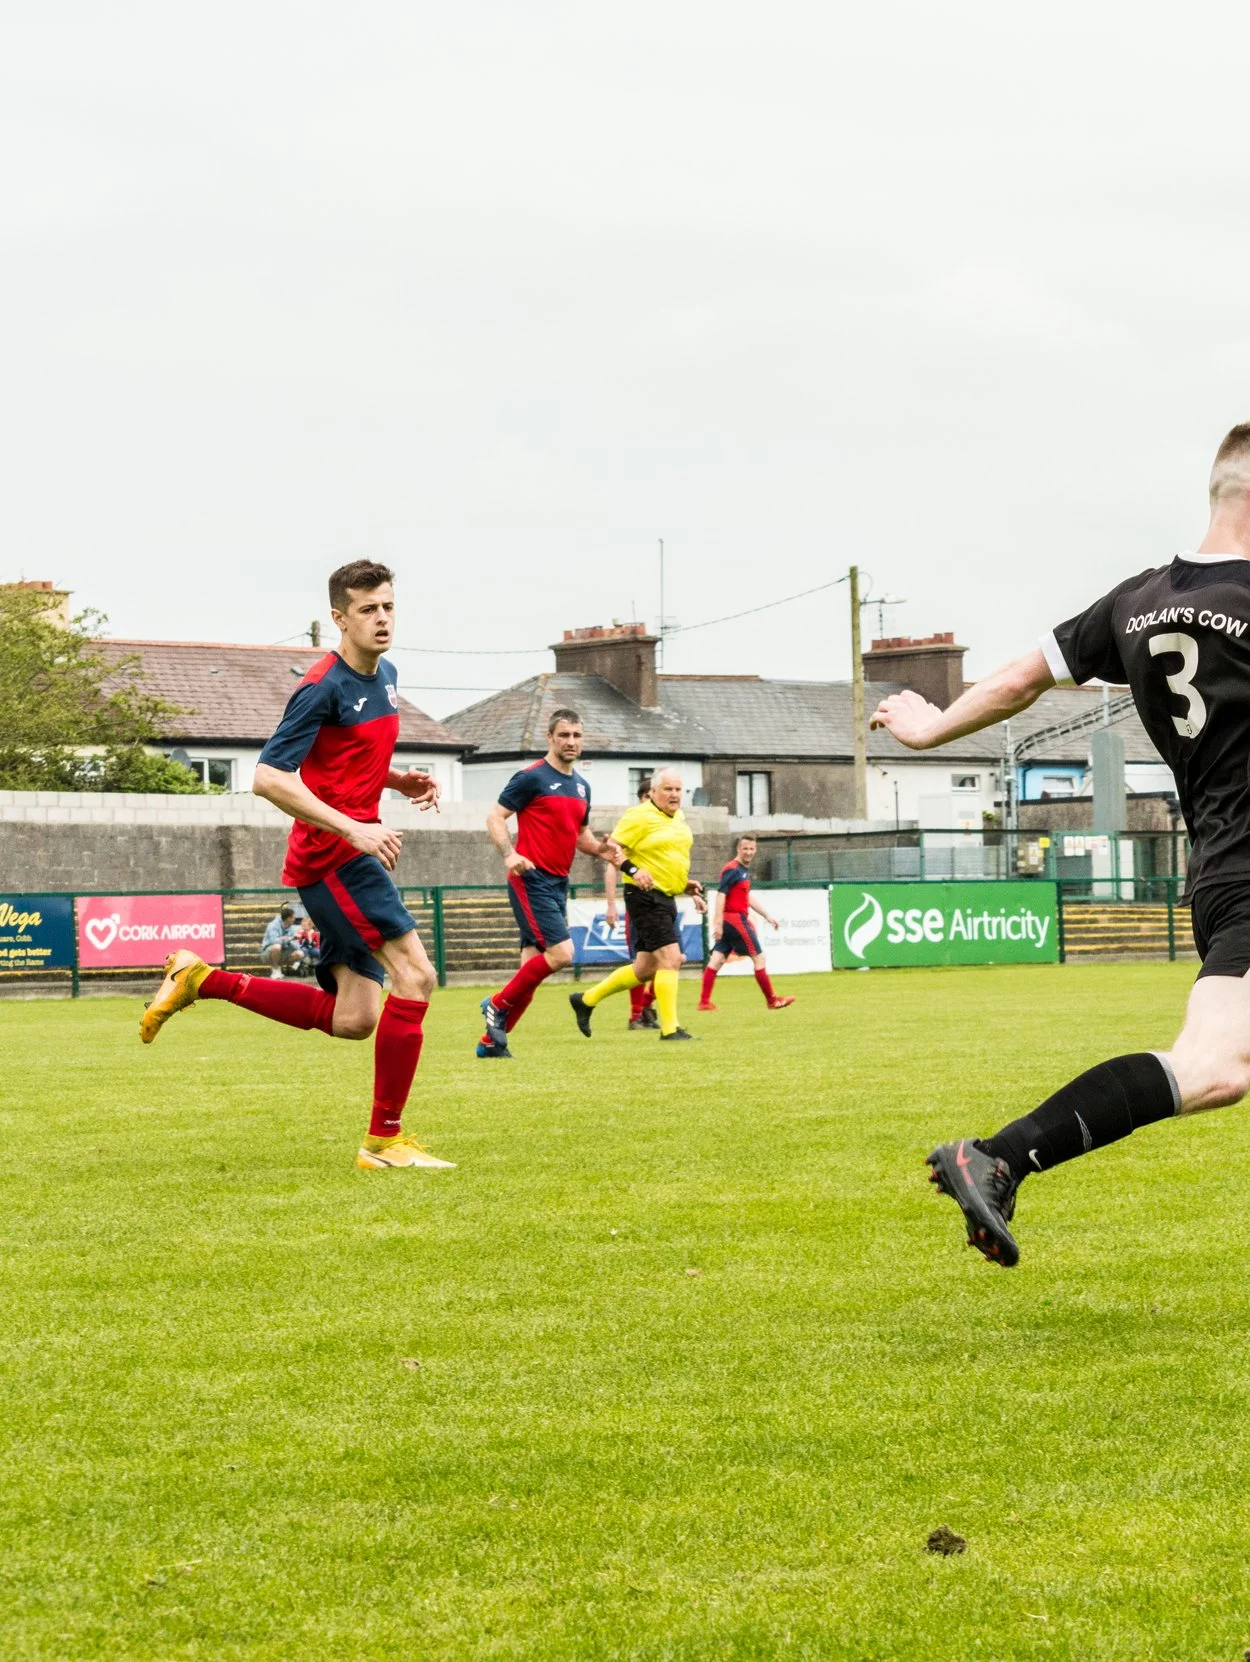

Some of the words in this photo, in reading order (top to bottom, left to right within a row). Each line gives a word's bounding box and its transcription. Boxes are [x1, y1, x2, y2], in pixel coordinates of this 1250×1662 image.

[1125, 607, 1195, 634] DOOLAN'S
[1197, 609, 1249, 638] COW
[1148, 631, 1208, 740] 3
[119, 924, 160, 942] CORK
[160, 923, 217, 940] AIRPORT
[886, 908, 945, 944] sse
[949, 907, 1050, 948] Airtricity
